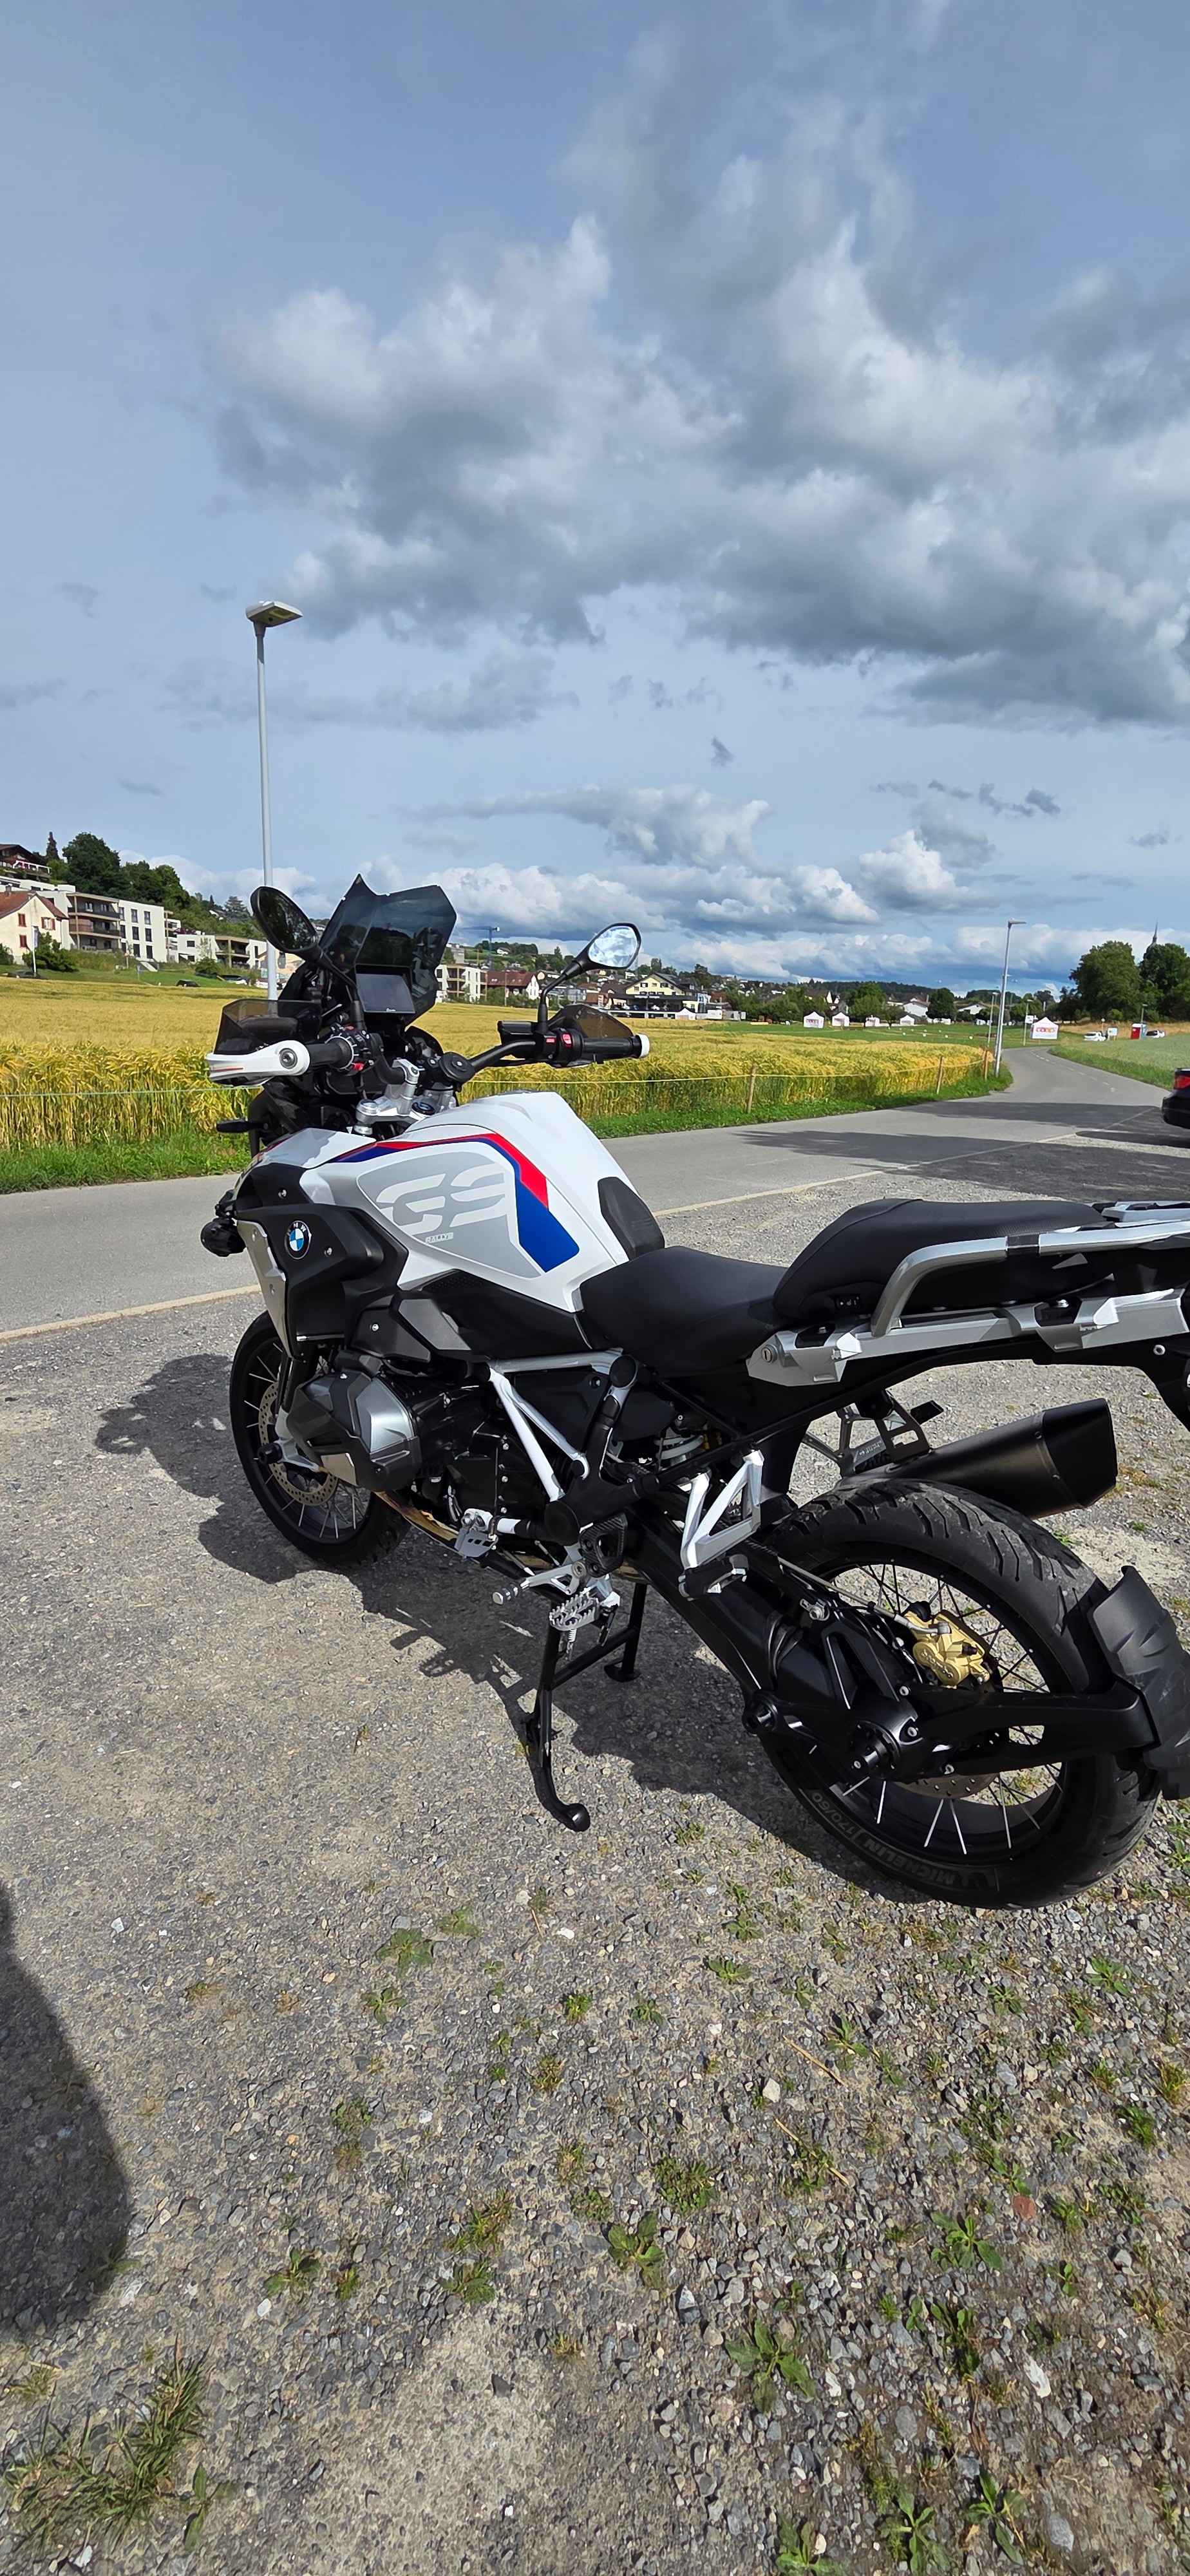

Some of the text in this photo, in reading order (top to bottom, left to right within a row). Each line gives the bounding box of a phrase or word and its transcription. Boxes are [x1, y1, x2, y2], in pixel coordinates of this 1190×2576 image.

[376, 1163, 507, 1235] GS
[811, 1792, 855, 1835] 170/60
[862, 1837, 957, 1886] MICHELIN
